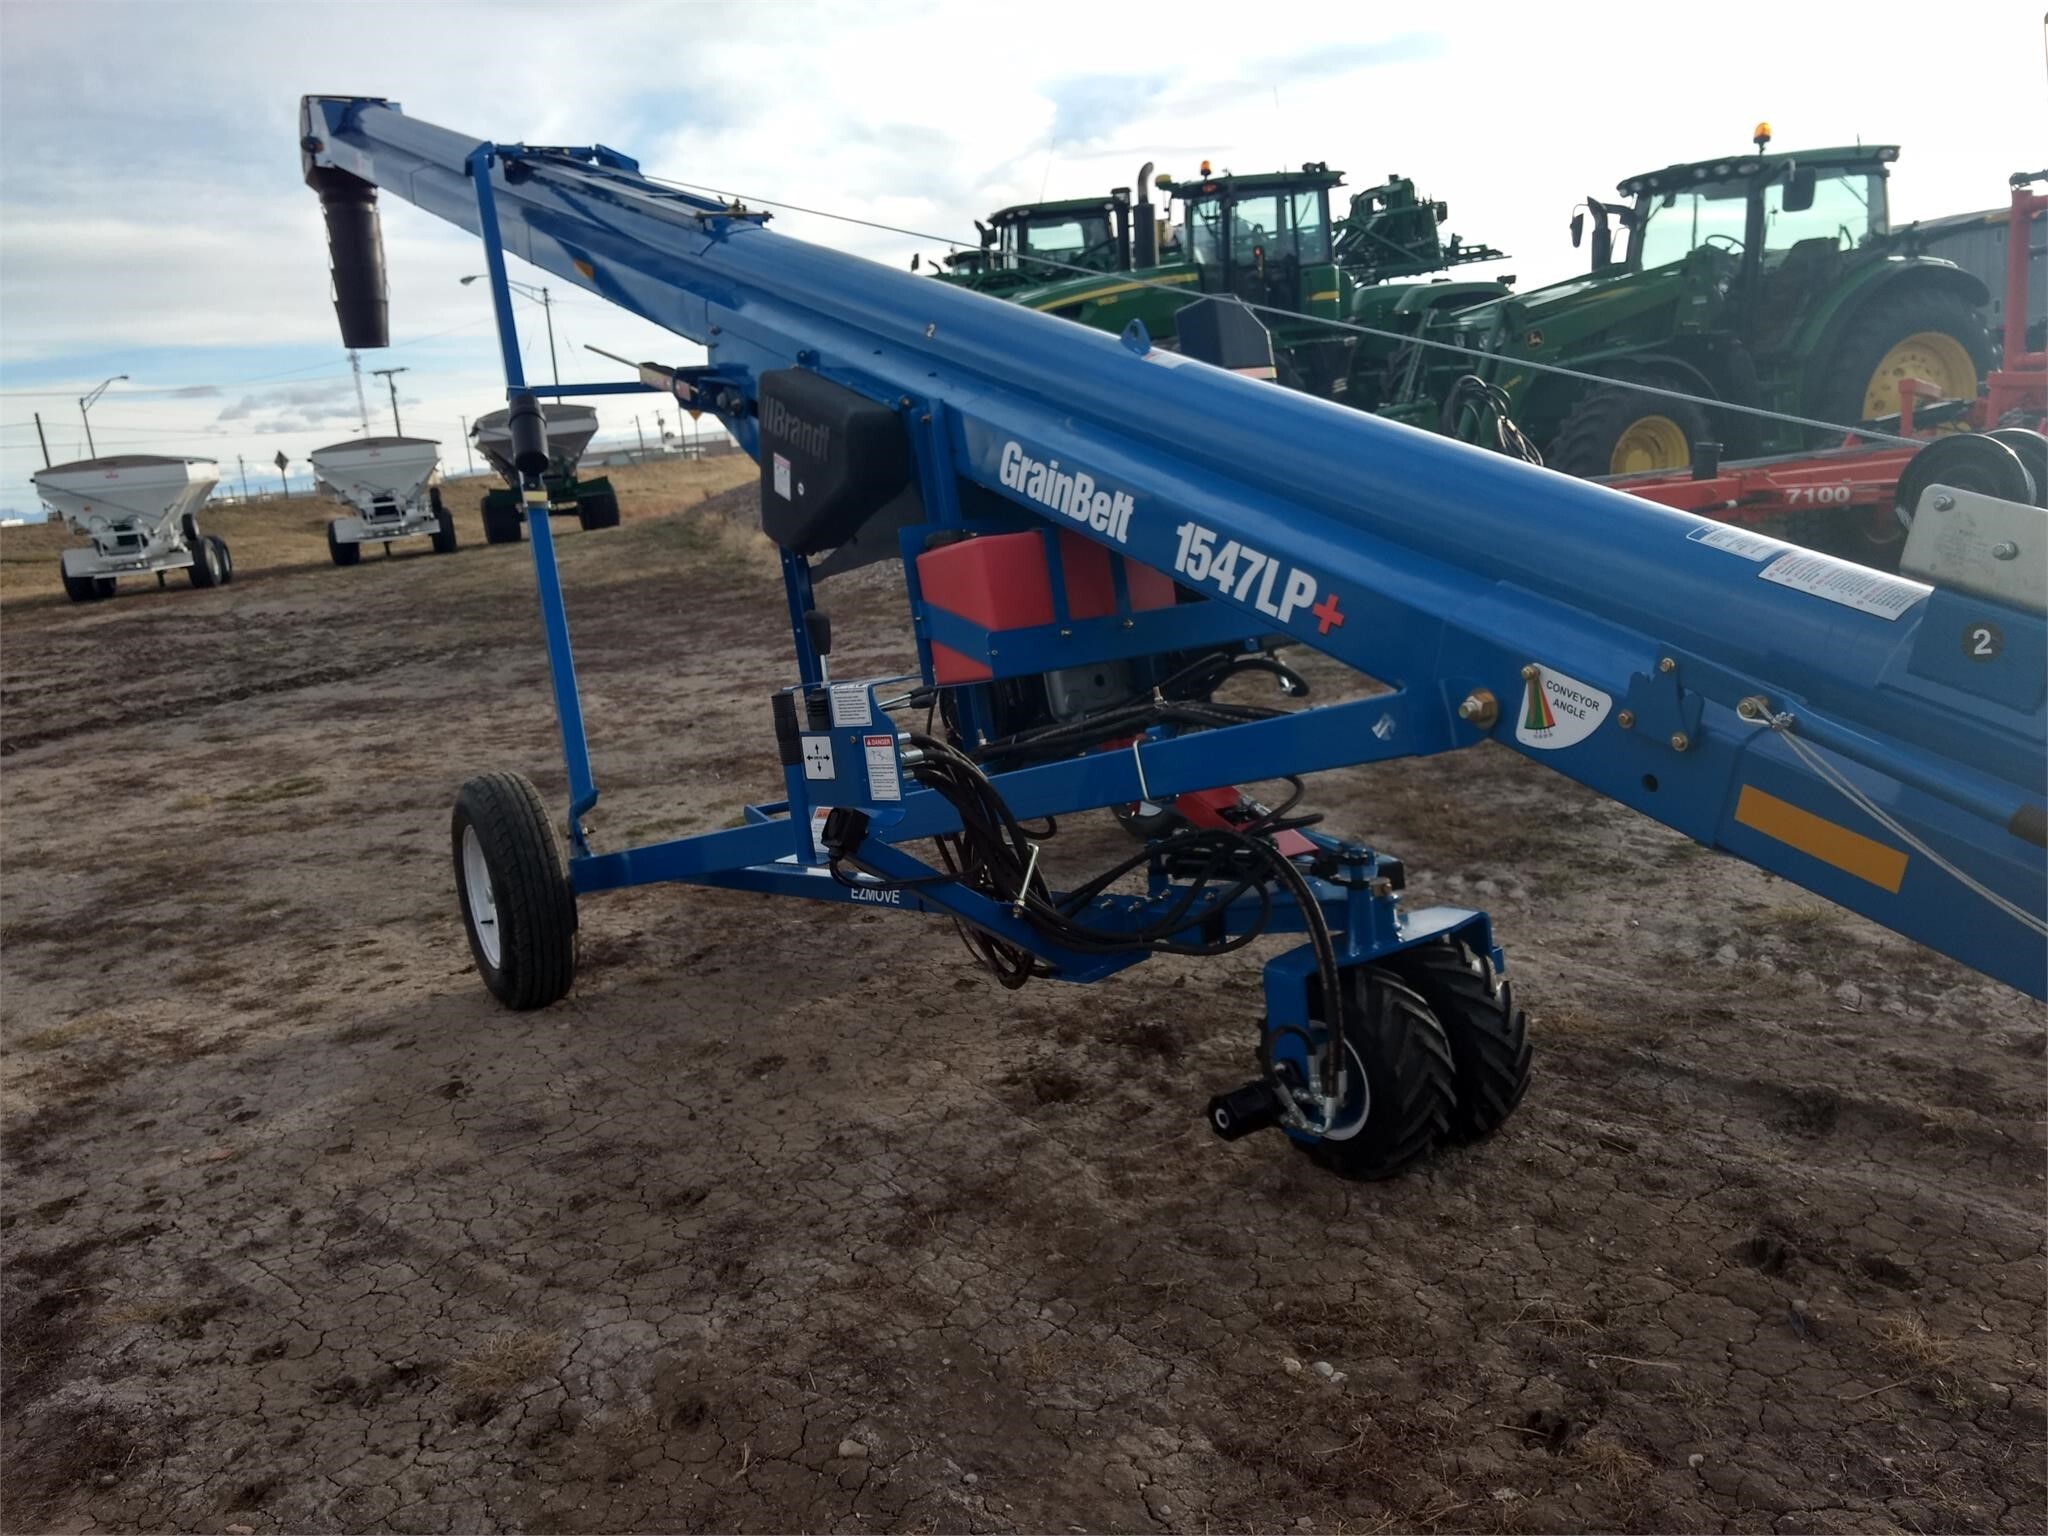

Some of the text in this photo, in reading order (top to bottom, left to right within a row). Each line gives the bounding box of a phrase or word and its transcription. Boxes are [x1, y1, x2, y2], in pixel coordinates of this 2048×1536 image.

[999, 440, 1134, 545] GrainBelt
[1785, 485, 1851, 505] 7100
[1972, 628, 1993, 655] 2
[1546, 680, 1600, 711] CONVEYOR
[1552, 698, 1587, 720] ANGLE
[871, 738, 892, 746] DANGER
